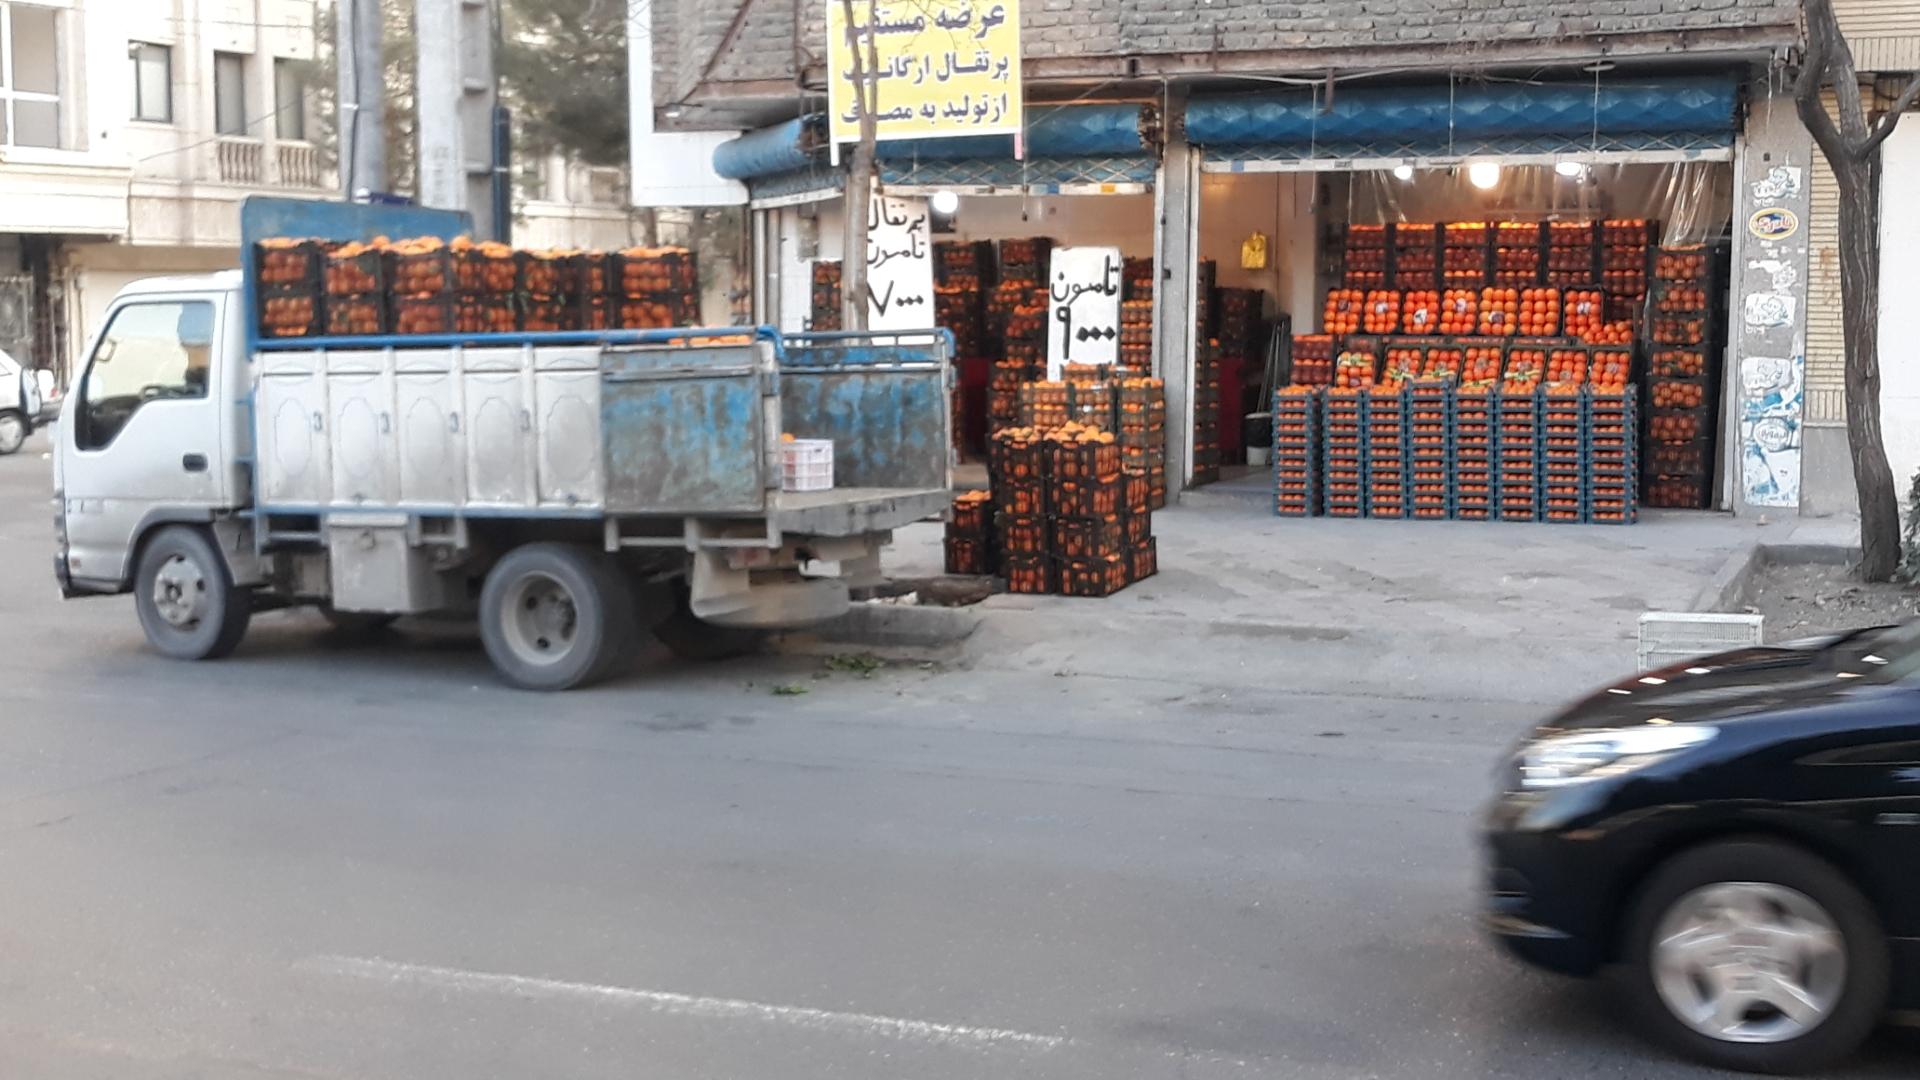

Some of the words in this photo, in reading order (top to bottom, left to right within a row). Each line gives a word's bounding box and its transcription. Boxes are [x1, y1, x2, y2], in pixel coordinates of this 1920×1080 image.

[844, 7, 925, 47] مستقی
[934, 2, 1005, 39] عرضه
[936, 51, 1009, 84] پرتقال
[841, 99, 913, 123] مصف
[919, 103, 936, 125] به
[867, 198, 926, 235] پرتقال
[1050, 254, 1120, 308] تامسون
[1055, 305, 1117, 360] ۹۰۰۰
